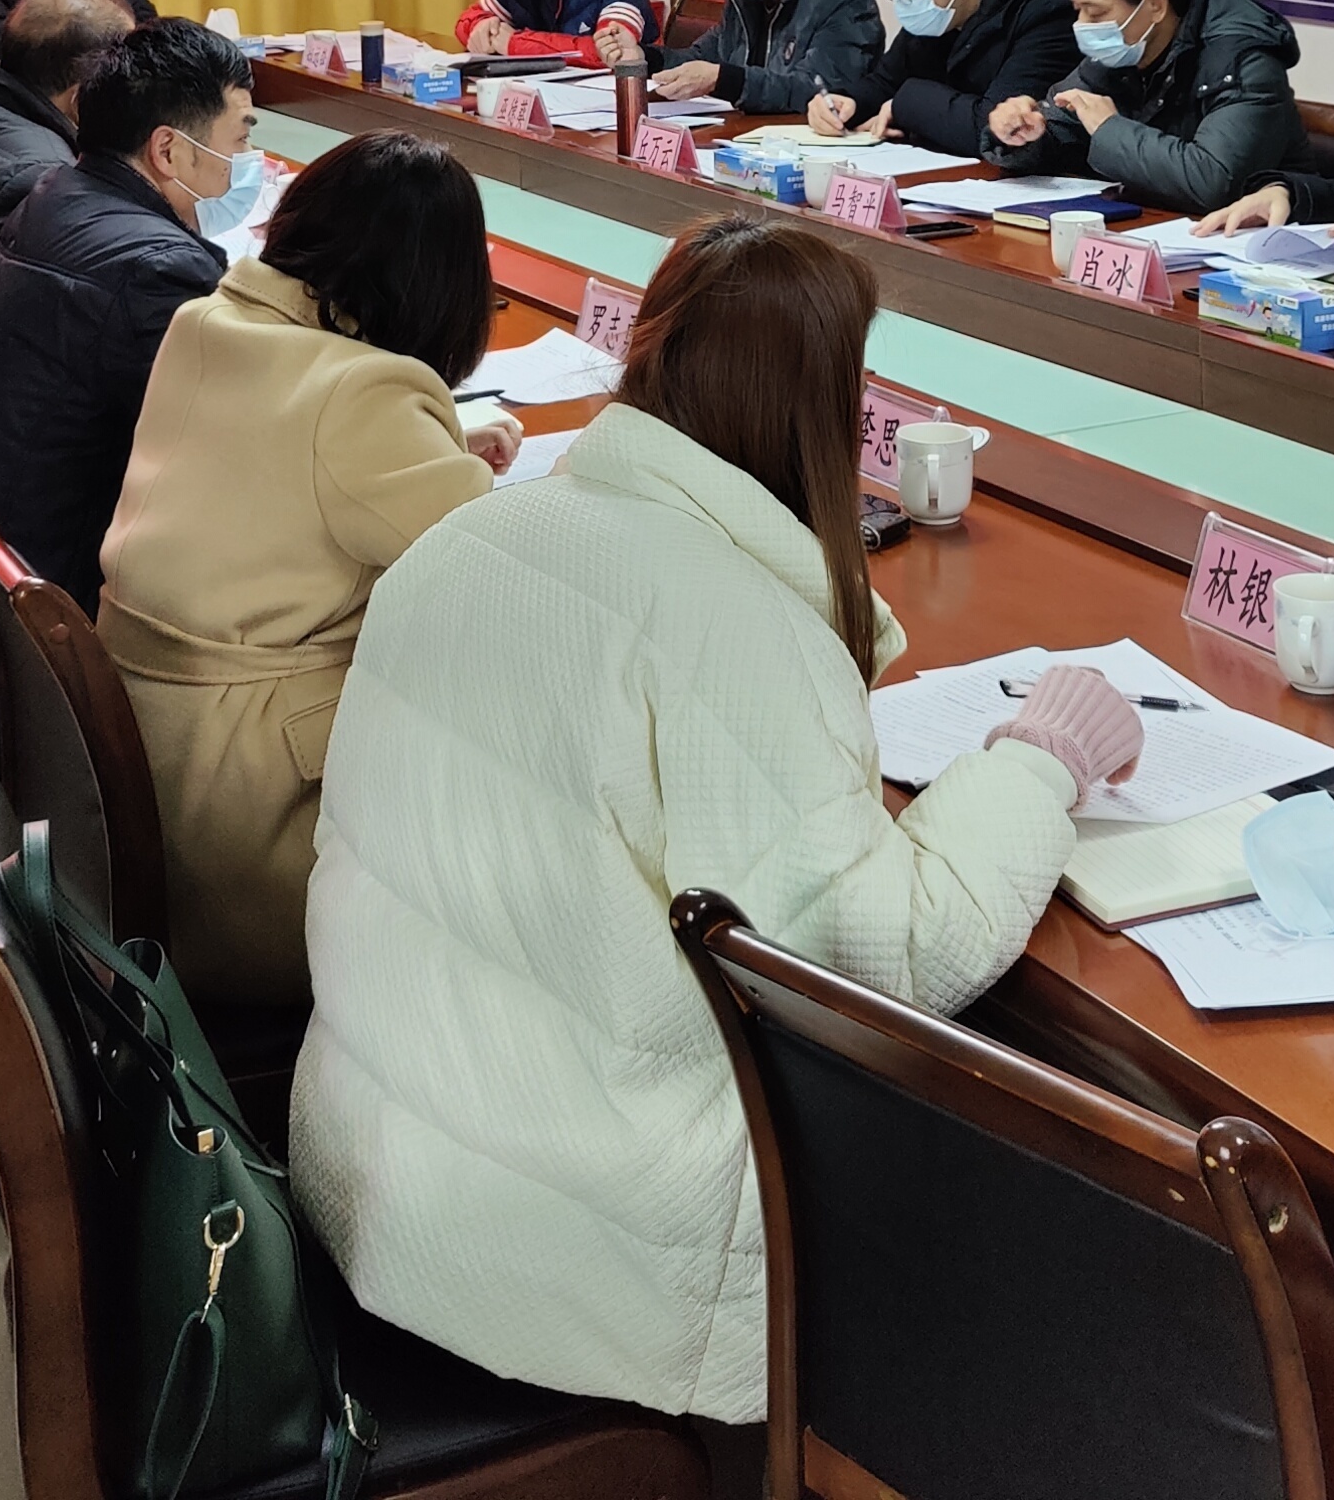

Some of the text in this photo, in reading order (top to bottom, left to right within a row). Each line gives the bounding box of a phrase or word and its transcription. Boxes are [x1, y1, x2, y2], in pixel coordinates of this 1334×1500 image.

[831, 184, 877, 228] 马智平
[1080, 246, 1134, 296] 肖冰
[1203, 547, 1274, 633] 林银
